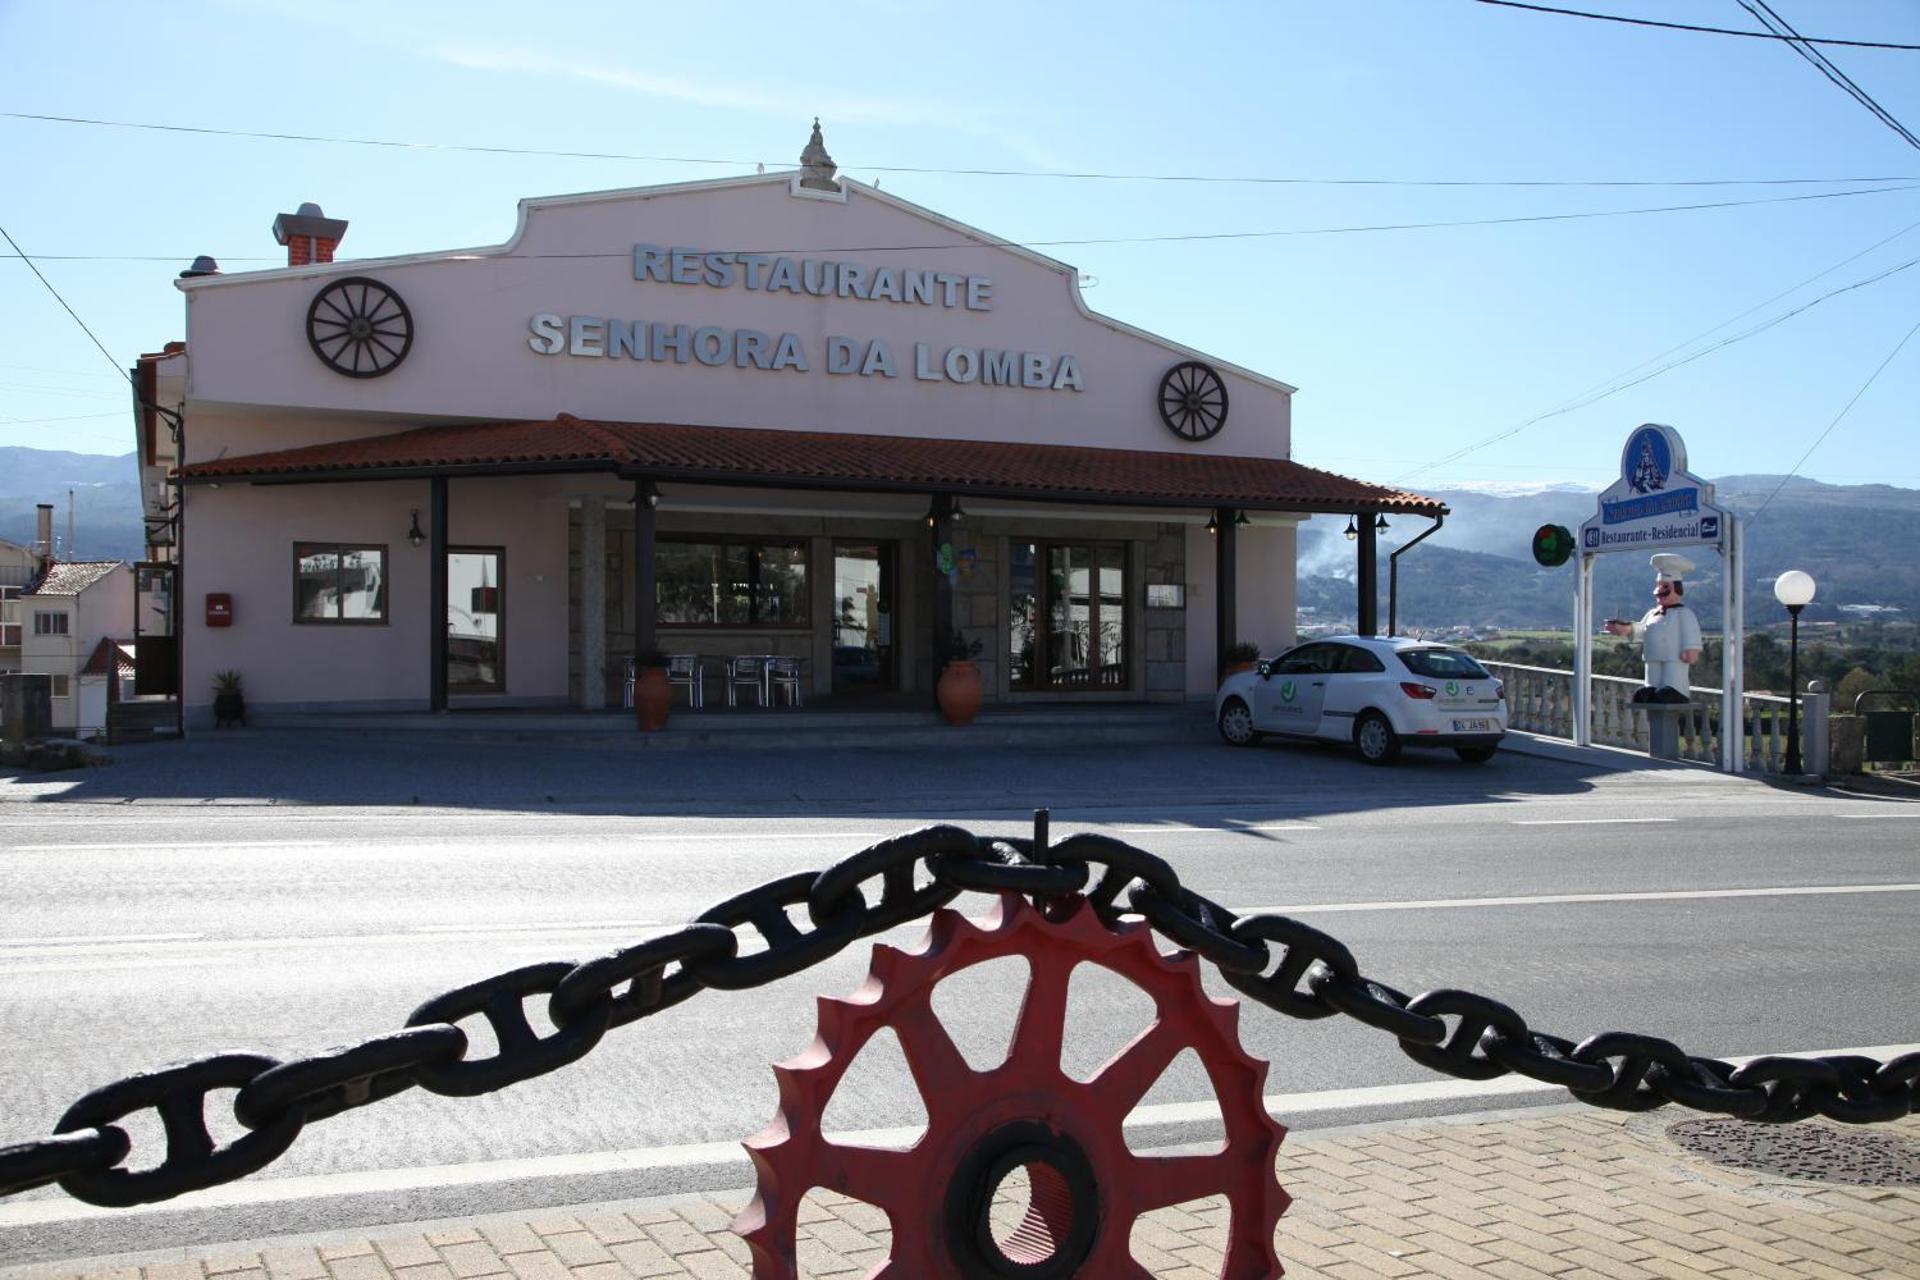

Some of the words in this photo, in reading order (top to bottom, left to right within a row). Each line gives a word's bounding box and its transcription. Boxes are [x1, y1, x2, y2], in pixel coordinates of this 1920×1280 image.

[632, 243, 993, 312] RESTAURANTE
[528, 312, 808, 373] SENHORA
[826, 335, 897, 378] DA
[915, 342, 1085, 392] LOMBA
